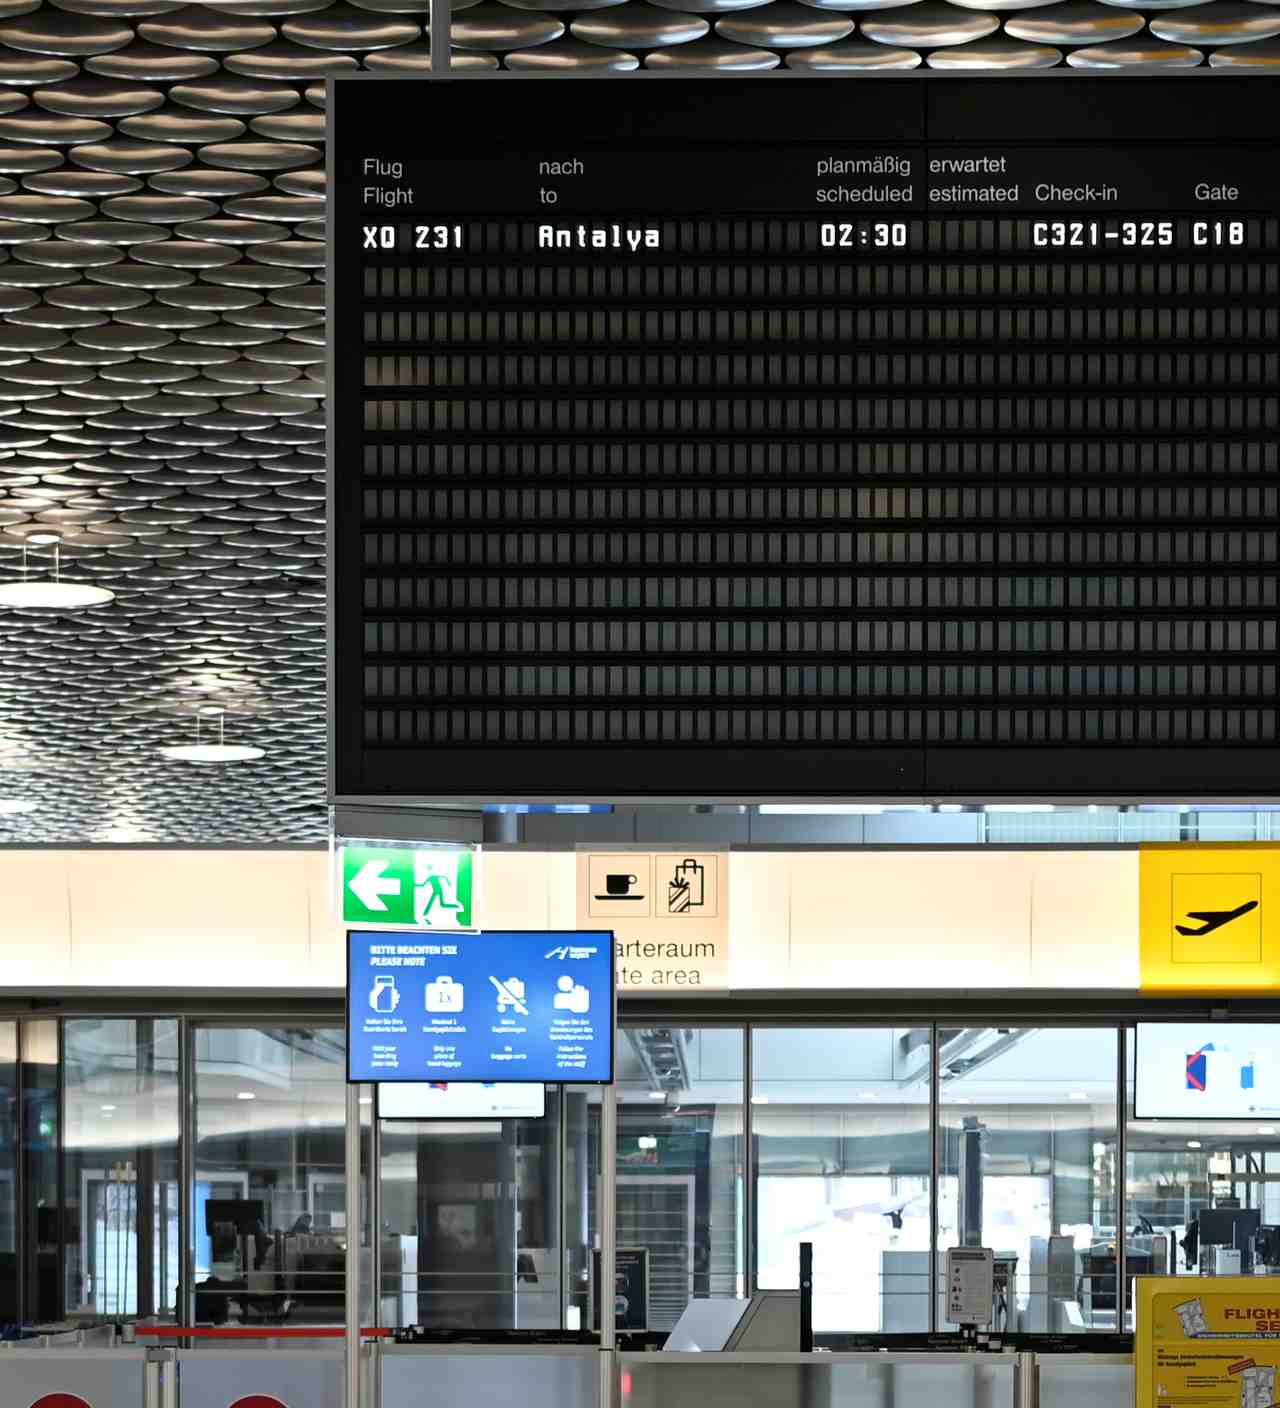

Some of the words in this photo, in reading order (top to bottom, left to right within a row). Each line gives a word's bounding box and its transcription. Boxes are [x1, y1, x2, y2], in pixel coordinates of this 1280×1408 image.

[364, 158, 403, 179] Flug
[539, 158, 584, 175] nach
[817, 155, 911, 177] planmäßig
[929, 156, 1006, 173] erwartet
[363, 186, 414, 208] Flight
[540, 187, 558, 204] to
[816, 184, 913, 202] scheduled
[929, 184, 1019, 202] estimated
[1035, 183, 1118, 201] Check-in
[1194, 183, 1239, 201] Gate
[415, 225, 462, 249] 231
[538, 224, 660, 252] Antalya
[821, 223, 907, 247] 02:30
[1033, 222, 1173, 246] C321-325
[1193, 222, 1244, 246] C18
[615, 939, 715, 958] arteraum
[651, 969, 701, 985] area
